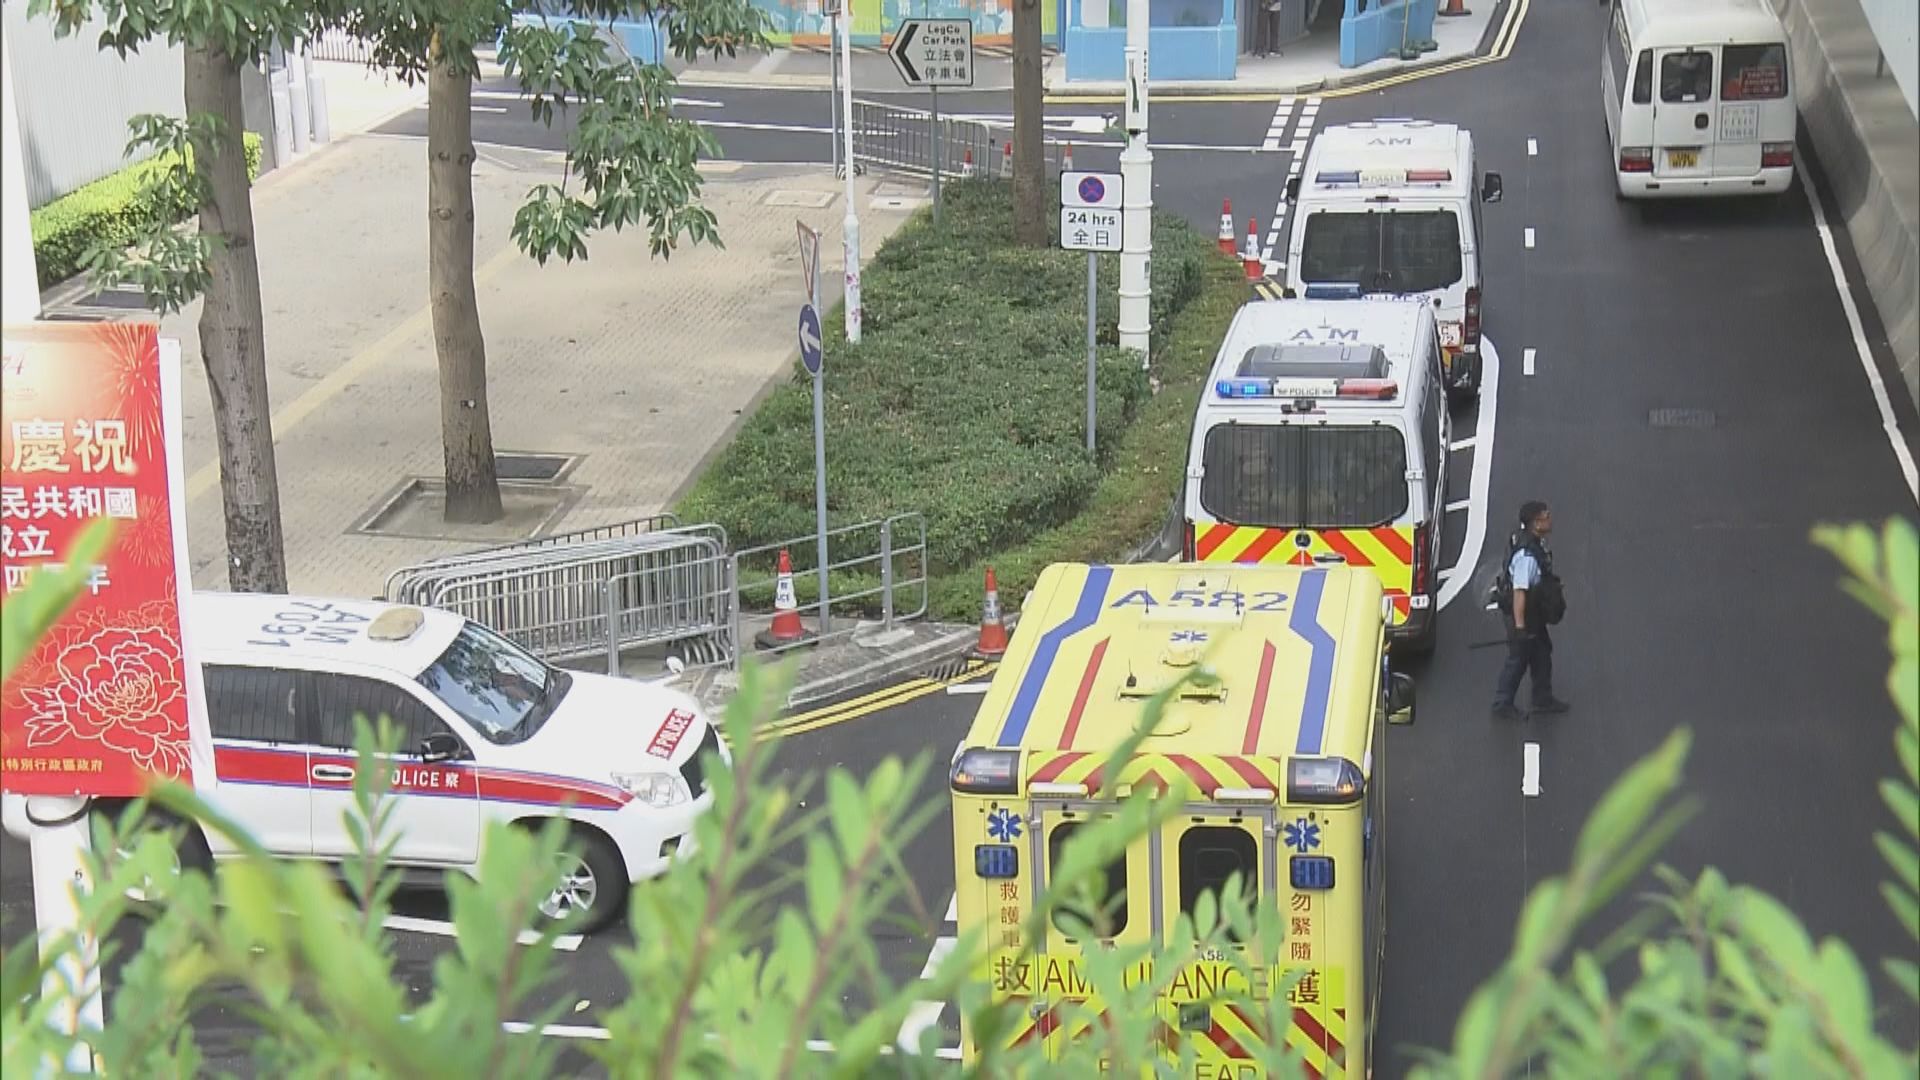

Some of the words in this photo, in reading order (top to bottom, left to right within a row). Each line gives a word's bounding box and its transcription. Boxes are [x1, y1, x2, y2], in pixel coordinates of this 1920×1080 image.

[927, 23, 960, 36] LegCo
[922, 36, 940, 45] Car
[942, 36, 966, 45] Park
[923, 48, 965, 62] 立法會
[924, 67, 966, 80] 停車場
[1368, 137, 1412, 146] AM
[1068, 212, 1088, 224] 24
[1092, 212, 1115, 225] hrs
[1072, 229, 1110, 246] 全日
[1289, 387, 1320, 396] POLICE
[2, 416, 133, 474] 慶祝
[1110, 590, 1289, 612] A582
[247, 601, 334, 648] 7091
[304, 608, 371, 645] AM
[2, 758, 103, 772] 特別行政區政府
[389, 767, 440, 788] OLICE
[1290, 892, 1312, 961] 勿緊隨
[993, 955, 1032, 993] 救
[1042, 957, 1270, 1001] AMULANCE
